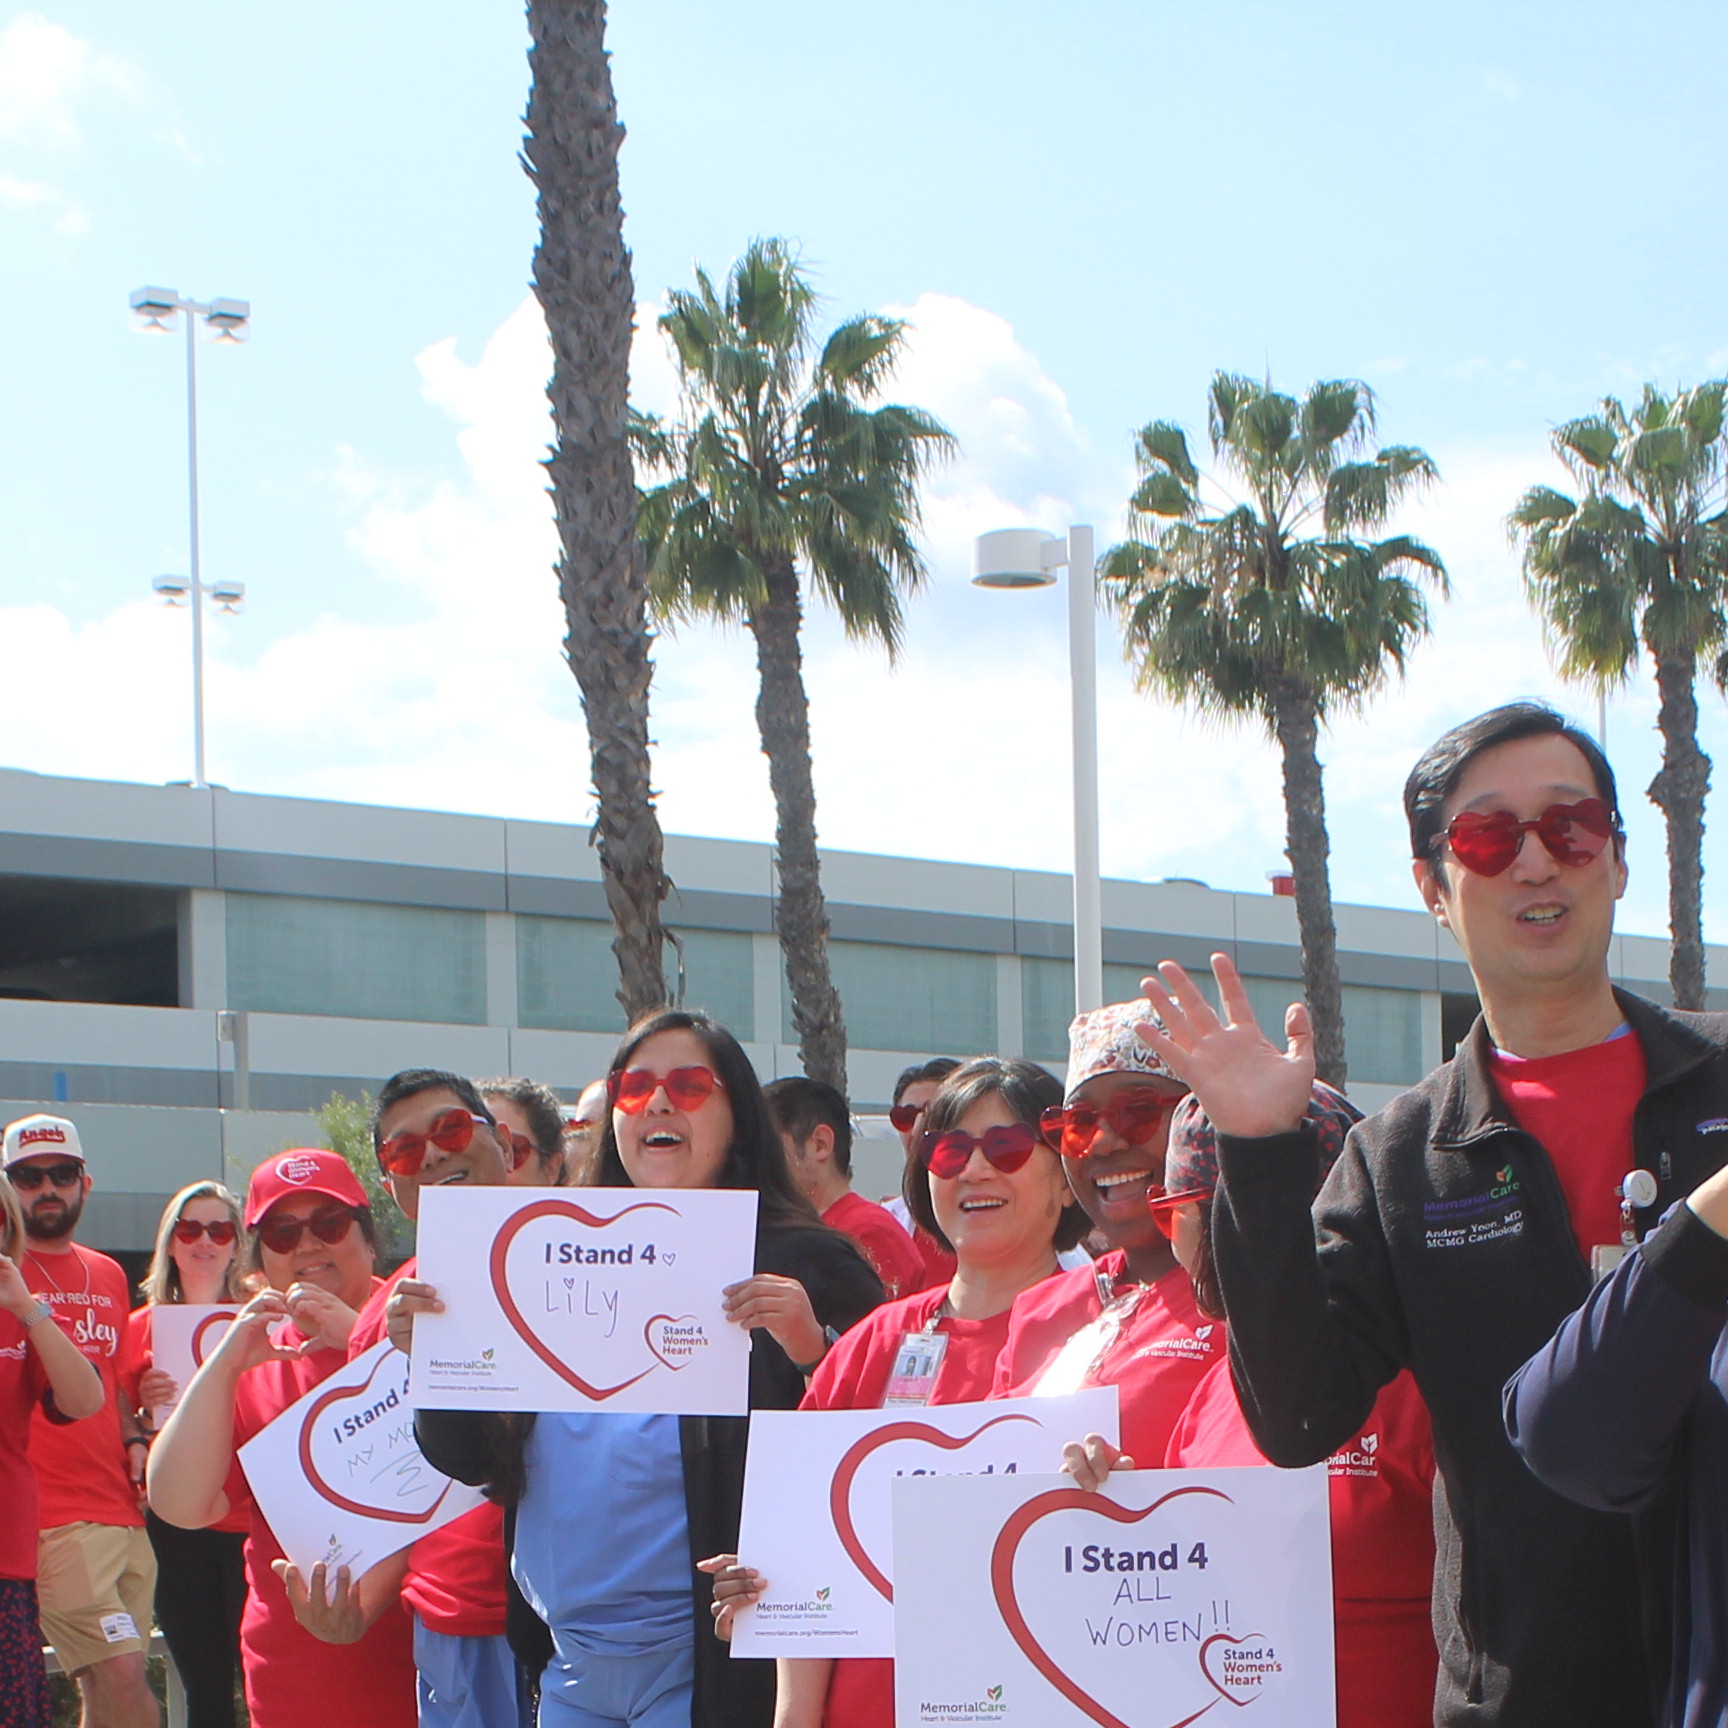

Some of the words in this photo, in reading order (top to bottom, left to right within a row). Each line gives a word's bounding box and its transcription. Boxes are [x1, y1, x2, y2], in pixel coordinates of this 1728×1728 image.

[1424, 1181, 1520, 1212] MemorialCare
[1425, 1228, 1467, 1239] Andrew
[1504, 1210, 1522, 1223] MD
[1468, 1221, 1524, 1243] Cardiology
[545, 1243, 552, 1264] I
[558, 1242, 633, 1265] Stand
[640, 1244, 656, 1265] 4
[40, 1292, 66, 1305] EAR
[66, 1293, 90, 1306] RED
[92, 1294, 113, 1308] FOR
[73, 1308, 119, 1357] sley
[663, 1326, 694, 1336] Stand
[696, 1326, 703, 1335] 4
[662, 1336, 709, 1346] Women's
[1153, 1338, 1212, 1352] orialCare
[662, 1346, 693, 1356] Heart
[429, 1359, 496, 1369] MemorialCare
[333, 1427, 343, 1445] I
[343, 1388, 400, 1437] Stand
[1325, 1452, 1376, 1466] orialCar
[1328, 1467, 1345, 1476] cular
[1346, 1468, 1378, 1477] Institute
[1065, 1545, 1073, 1573] I
[1081, 1543, 1178, 1573] Stand
[1187, 1542, 1209, 1570] 4
[1113, 1577, 1172, 1606] ALL
[756, 1602, 833, 1612] MemorialCare
[1223, 1649, 1263, 1660] Stand
[1266, 1648, 1275, 1659] 4
[1223, 1660, 1283, 1673] Women's
[1224, 1674, 1263, 1686] Heart
[920, 1701, 1007, 1713] MemorialCare
